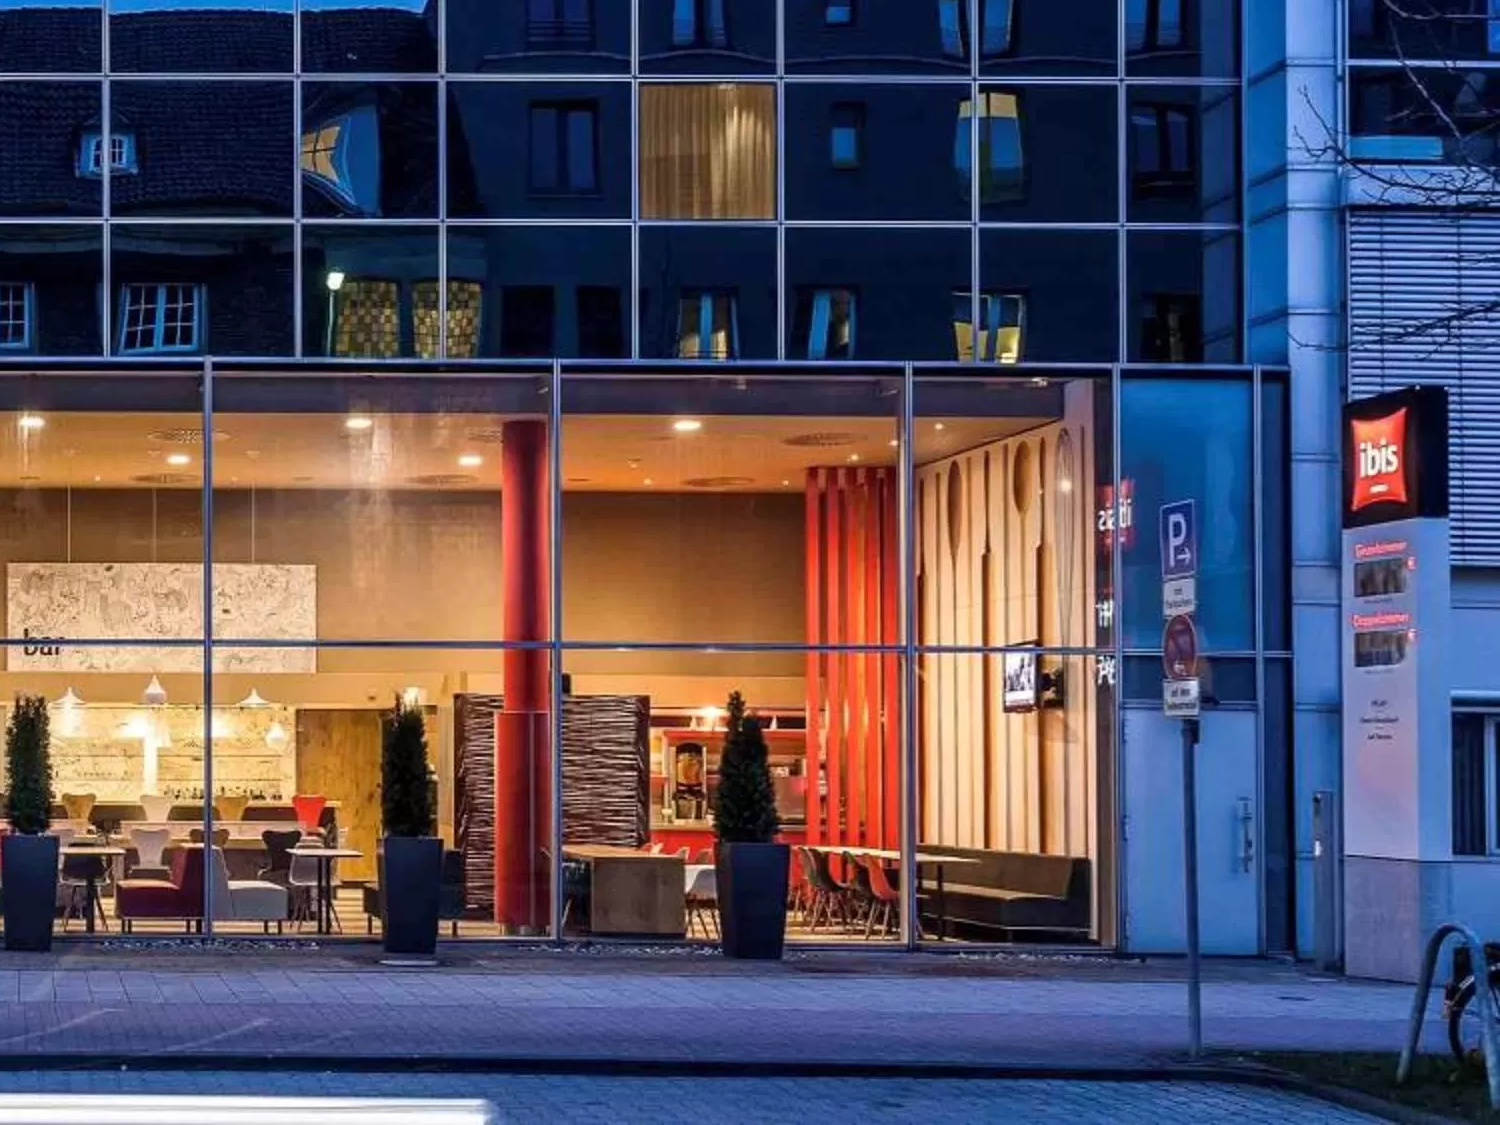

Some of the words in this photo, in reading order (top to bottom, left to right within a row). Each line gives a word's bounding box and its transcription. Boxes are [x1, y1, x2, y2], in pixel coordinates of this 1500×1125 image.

[1359, 437, 1399, 478] ibis
[1169, 513, 1187, 568] P
[23, 628, 66, 656] bar
